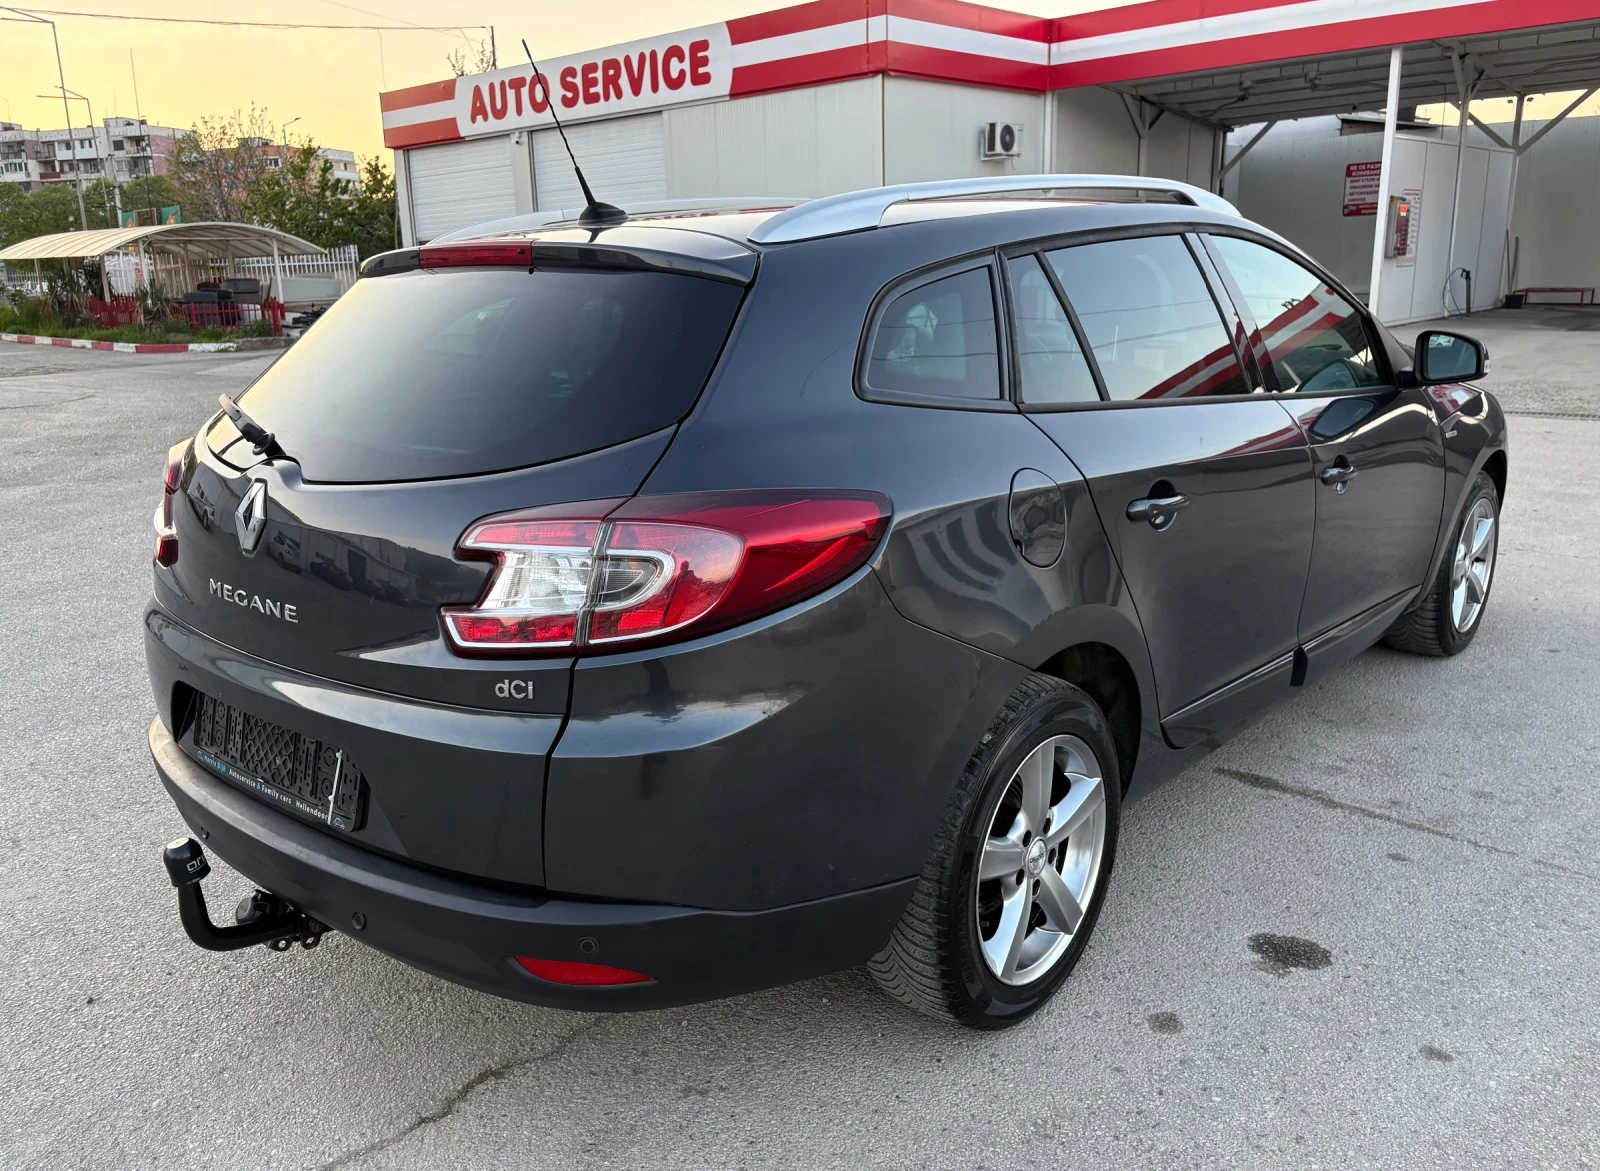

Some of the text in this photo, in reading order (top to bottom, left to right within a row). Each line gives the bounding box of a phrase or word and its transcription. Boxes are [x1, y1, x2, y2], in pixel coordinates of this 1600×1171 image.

[470, 39, 712, 125] AUTO SERVICE
[209, 577, 299, 624] MEGANE
[494, 679, 534, 700] dCi
[229, 768, 256, 788] Autoservice
[261, 784, 280, 800] Family
[280, 794, 292, 804] cars
[295, 799, 329, 821] Hellendoor
